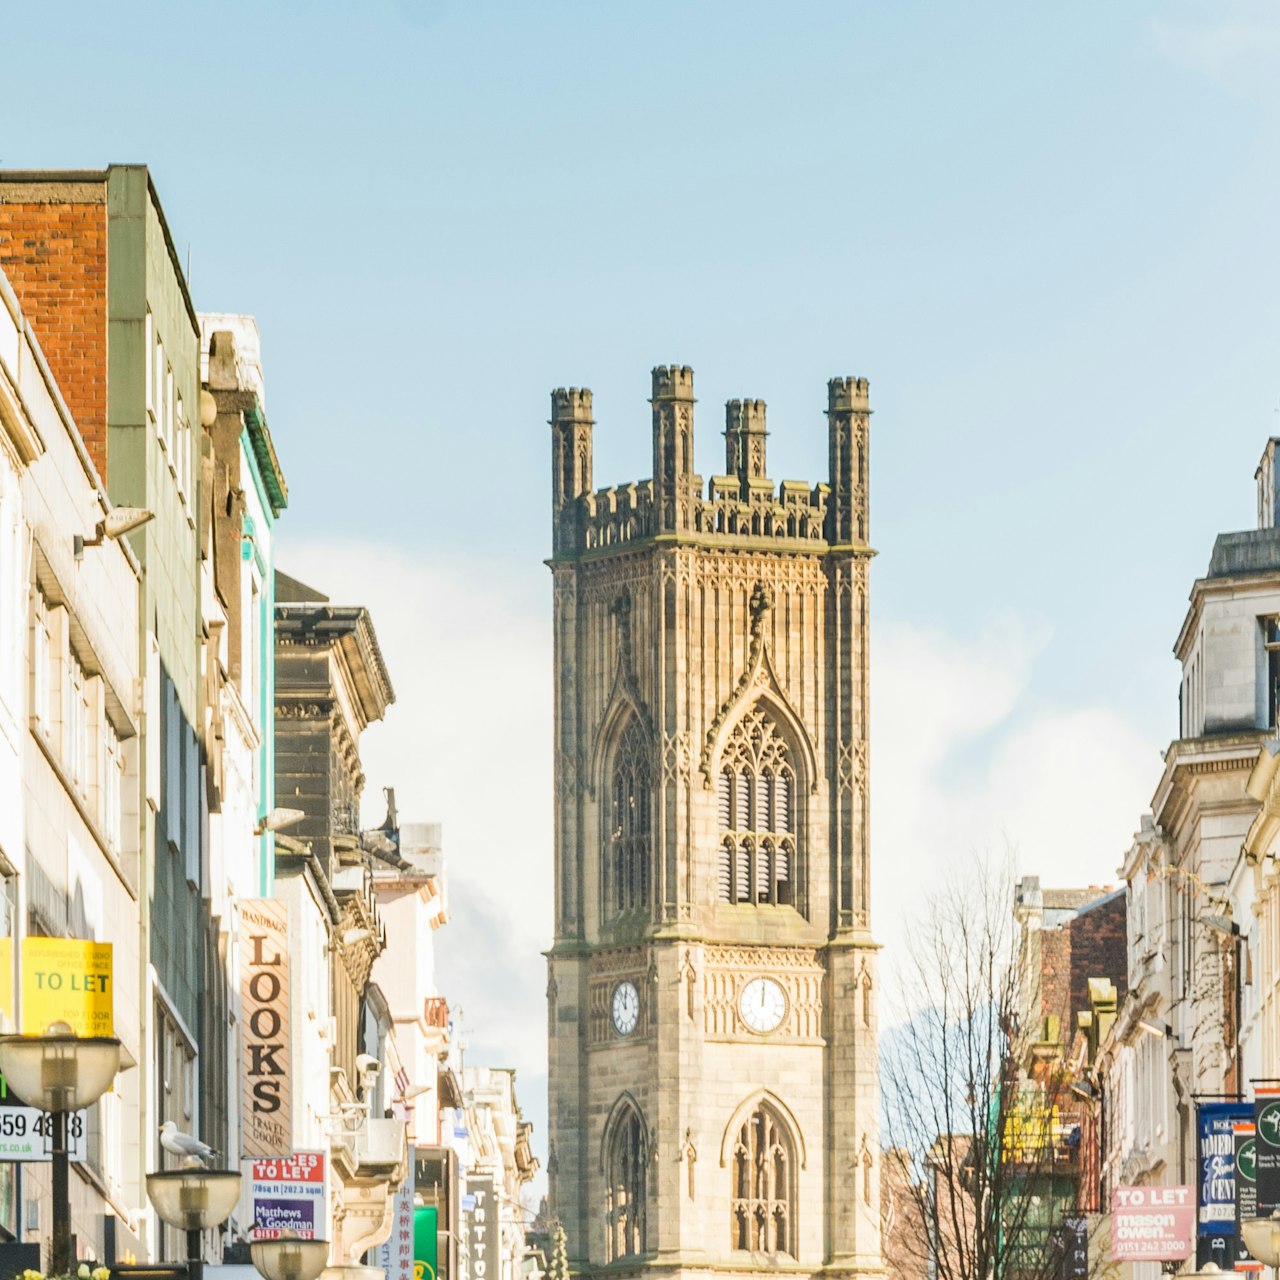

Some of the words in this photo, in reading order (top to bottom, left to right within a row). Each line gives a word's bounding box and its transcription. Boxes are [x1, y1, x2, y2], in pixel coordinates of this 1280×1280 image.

[34, 972, 63, 991] TO
[71, 973, 110, 993] LET
[246, 934, 286, 1114] LOOKS
[32, 1115, 83, 1139] 488
[256, 1165, 278, 1178] TO
[282, 1166, 312, 1180] LET
[1116, 1189, 1145, 1207] TO
[1150, 1188, 1189, 1206] LET
[255, 1205, 302, 1219] Matthews
[266, 1217, 313, 1230] Goodman
[1116, 1213, 1176, 1228] mason
[1117, 1241, 1140, 1252] 0151
[1141, 1240, 1161, 1252] 242
